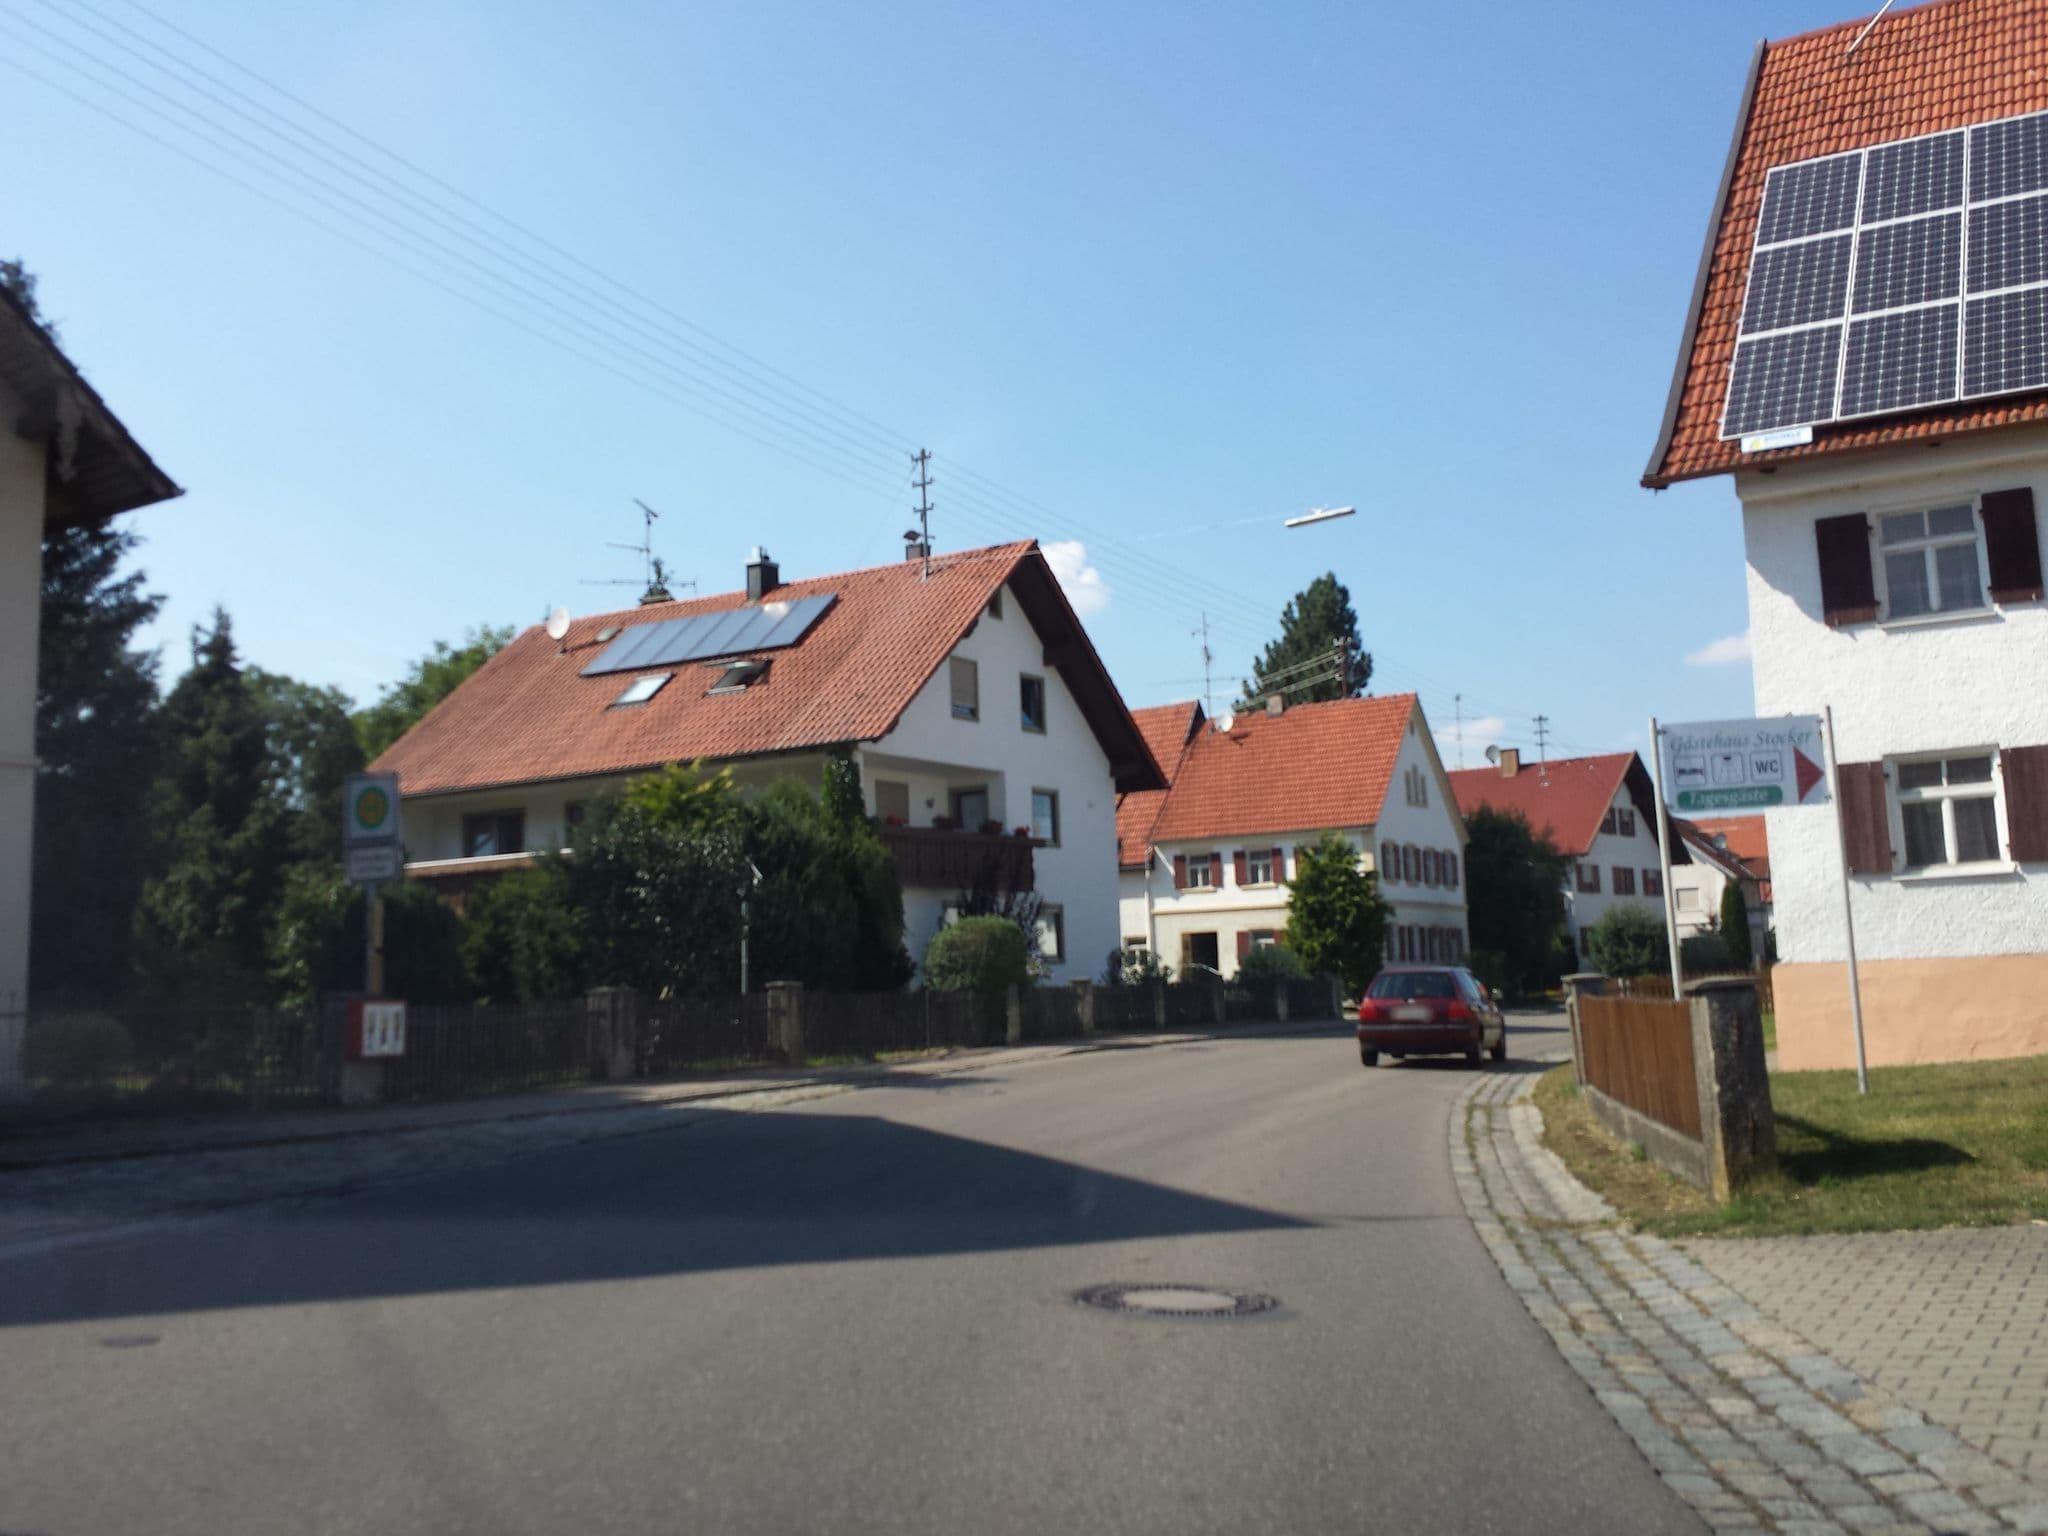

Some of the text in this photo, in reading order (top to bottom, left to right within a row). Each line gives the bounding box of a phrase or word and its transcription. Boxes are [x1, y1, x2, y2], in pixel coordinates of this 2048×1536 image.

[1669, 729, 1812, 754] Gästehaus Stocker
[1755, 760, 1779, 774] WC
